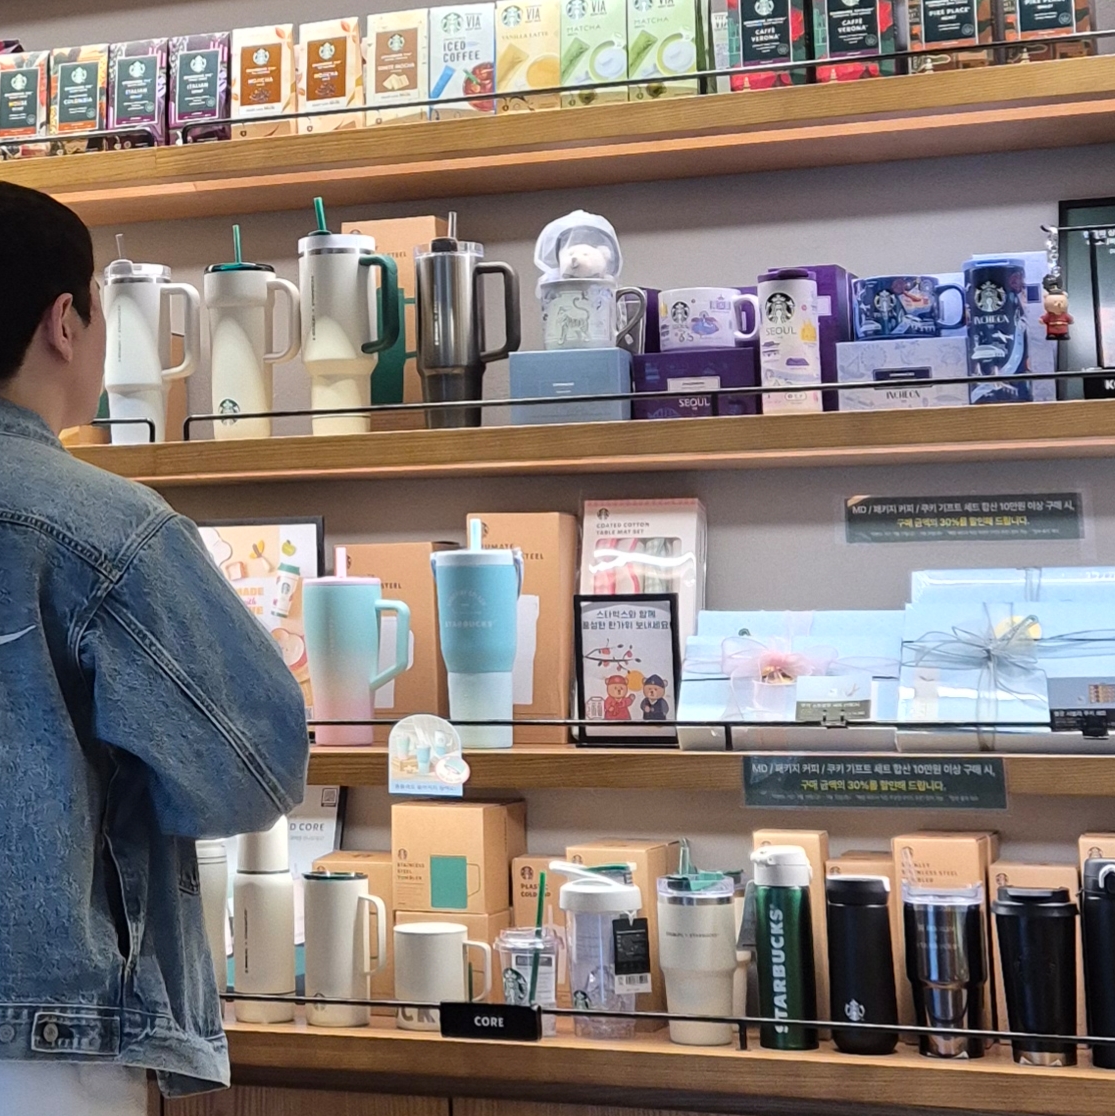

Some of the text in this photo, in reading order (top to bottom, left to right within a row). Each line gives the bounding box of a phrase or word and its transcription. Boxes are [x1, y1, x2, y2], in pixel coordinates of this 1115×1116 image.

[591, 0, 606, 13] VIA
[526, 6, 541, 20] VIA
[465, 14, 481, 27] VIA
[634, 17, 669, 25] MATCHA
[567, 24, 601, 33] MATCHA
[443, 41, 466, 52] ICED
[443, 51, 481, 63] COFFEE
[765, 326, 797, 336] SEOUL
[885, 390, 920, 399] INCHEON
[678, 398, 711, 408] SEOUL
[852, 506, 867, 514] MD
[898, 504, 914, 514] 커피
[920, 503, 937, 513] 쿠키
[938, 503, 963, 513] 기프트
[999, 501, 1026, 512] 10만원
[1027, 501, 1044, 511] 이상
[1045, 500, 1062, 511] 구매
[897, 518, 913, 528] 구매
[596, 610, 637, 619] 스타벅스와
[608, 621, 633, 630] 한가위
[635, 621, 669, 630] 보내세요
[751, 764, 768, 773] MD
[802, 763, 820, 774] 커피
[827, 763, 844, 774] 쿠키
[845, 763, 872, 774] 기프트
[873, 763, 892, 774] 세트
[893, 763, 911, 774] 합산
[912, 764, 941, 775] 10만원
[943, 764, 961, 775] 이상
[963, 764, 982, 775] 구매
[800, 780, 818, 791] 구매
[908, 780, 946, 792] 드립니다.
[298, 822, 325, 831] CORE
[769, 908, 789, 1034] STARBUCKS
[473, 1016, 504, 1028] CORE
